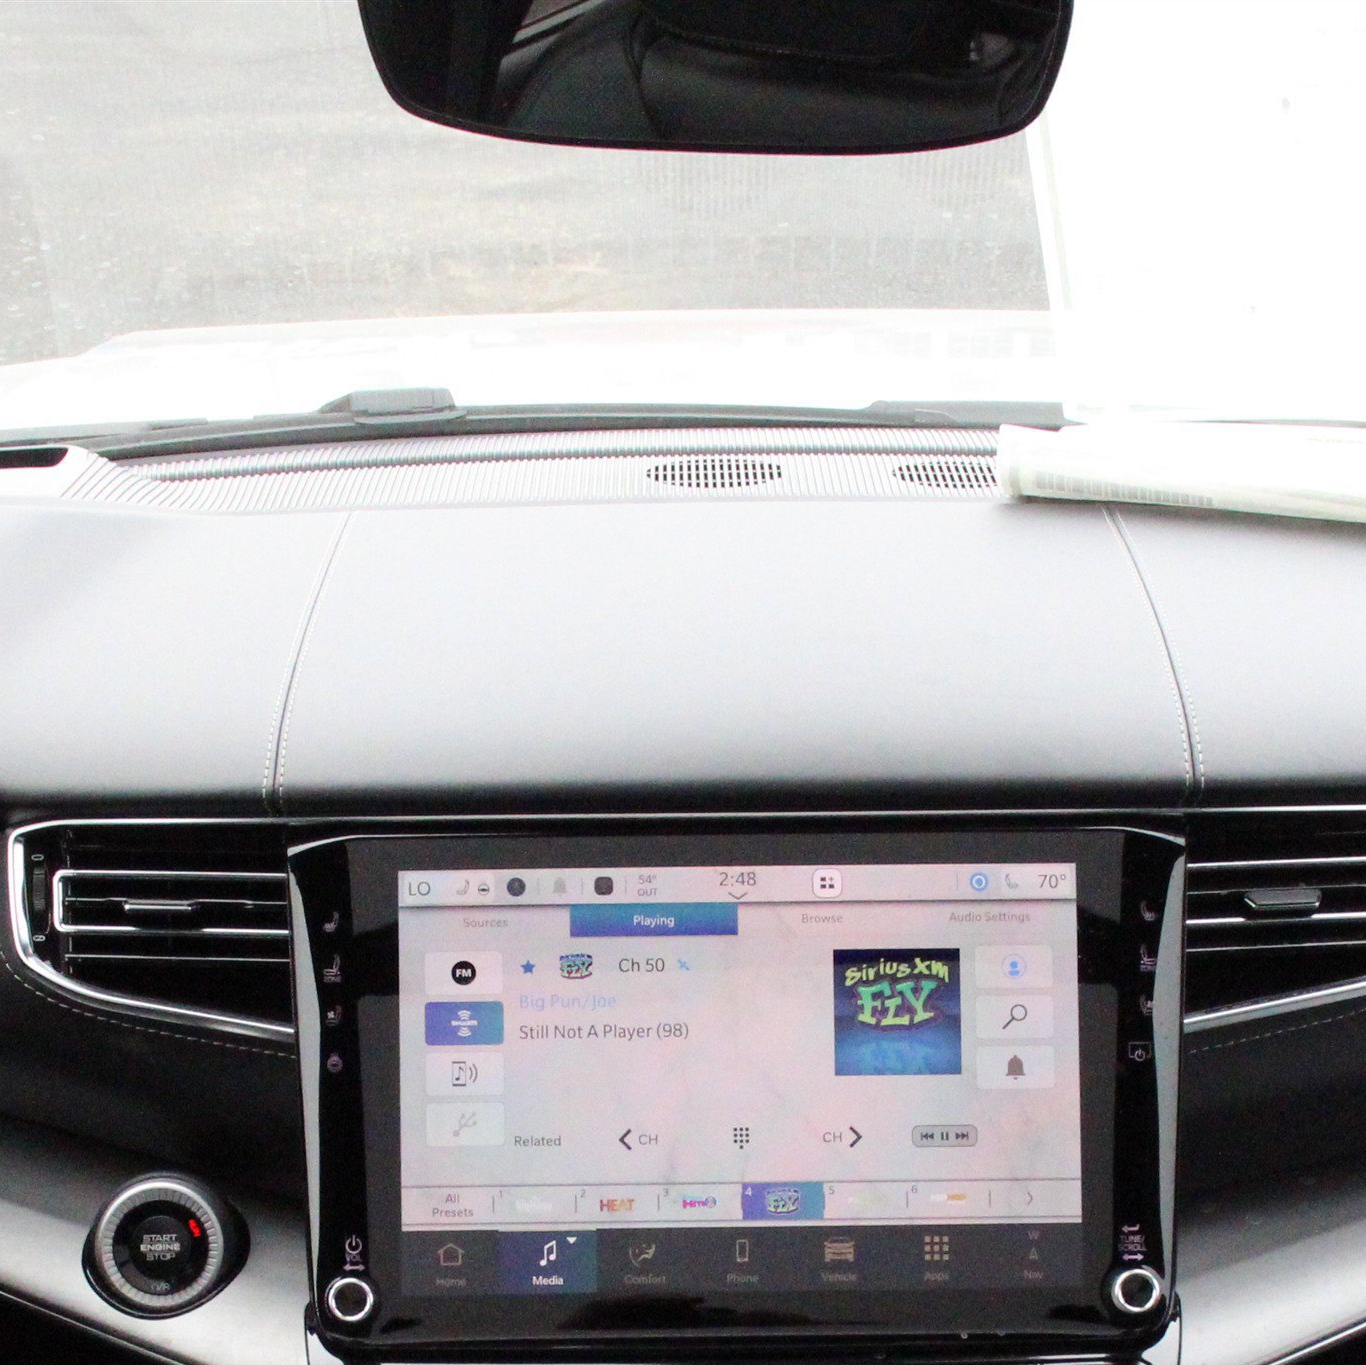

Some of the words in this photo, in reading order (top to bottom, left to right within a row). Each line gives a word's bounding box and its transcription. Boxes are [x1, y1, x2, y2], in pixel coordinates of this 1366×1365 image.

[719, 871, 757, 887] 2:48
[1037, 873, 1067, 889] 70°
[408, 881, 431, 896] LO
[637, 888, 657, 897] OUT
[463, 917, 509, 928] Sources
[633, 914, 675, 928] Playing
[801, 913, 843, 924] Browse
[949, 911, 982, 922] Audio
[985, 911, 1031, 923] Settings
[619, 958, 642, 973] Ch
[645, 958, 665, 973] 50
[455, 968, 473, 978] FM
[519, 994, 545, 1011] Big
[551, 994, 617, 1011] Pun/Joe
[856, 980, 939, 1026] FLY
[519, 1024, 550, 1039] Still
[554, 1024, 583, 1039] Not
[587, 1024, 599, 1038] A
[603, 1023, 652, 1041] Player
[656, 1023, 689, 1040] (98)
[514, 1135, 562, 1148] Related
[639, 1134, 659, 1146] CH
[823, 1131, 843, 1143] CH
[744, 1187, 752, 1197] 4
[445, 1193, 460, 1203] All
[599, 1199, 635, 1213] HEAT
[432, 1207, 474, 1218] Presets
[142, 1233, 178, 1242] START
[140, 1242, 181, 1251] ENGINE
[146, 1252, 176, 1261] STOP
[532, 1275, 564, 1286] Media
[624, 1274, 667, 1284] Comfort
[726, 1273, 759, 1284] Phone
[821, 1272, 857, 1282] Vehicle
[924, 1271, 950, 1283] Apps
[1024, 1270, 1044, 1280] Nav
